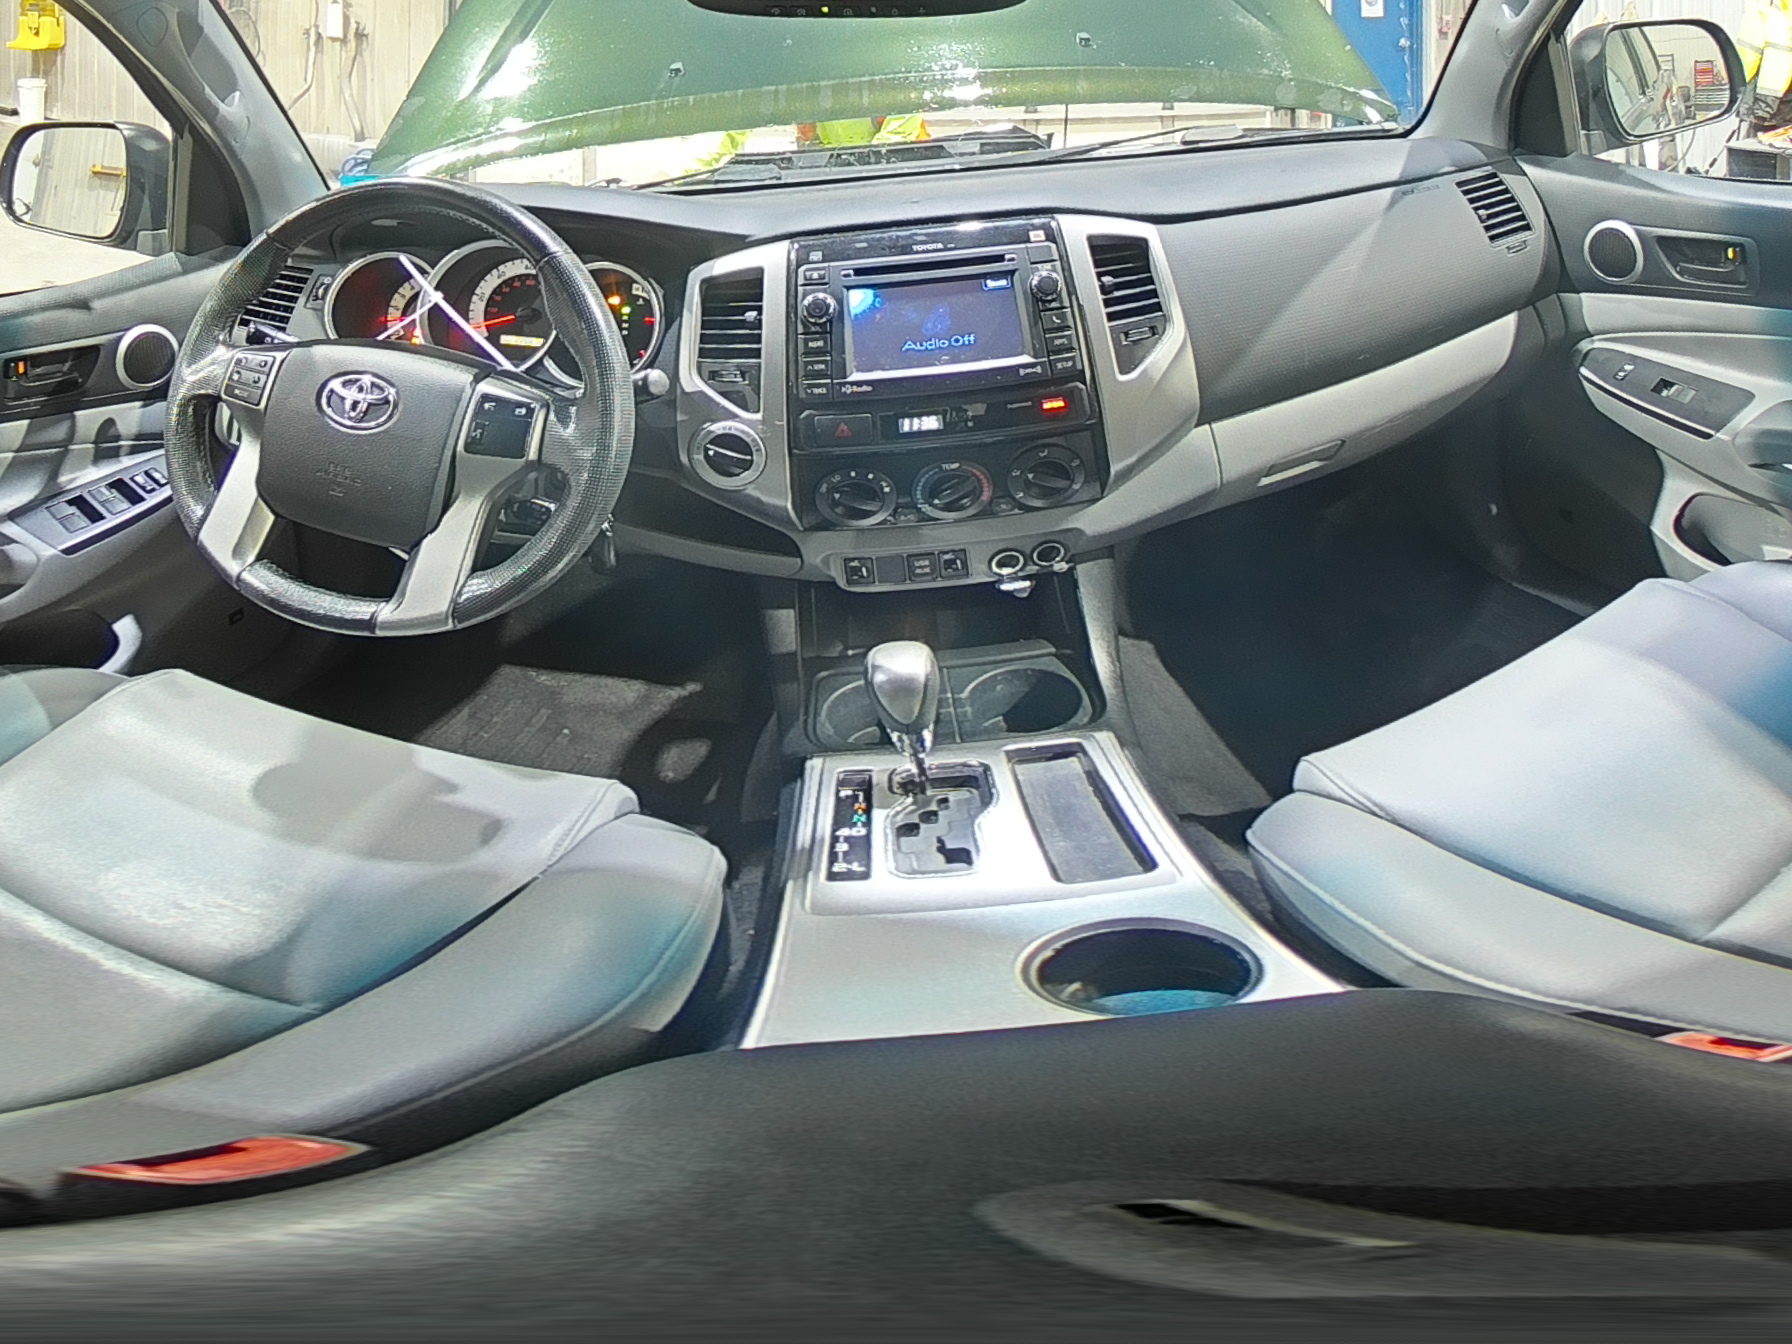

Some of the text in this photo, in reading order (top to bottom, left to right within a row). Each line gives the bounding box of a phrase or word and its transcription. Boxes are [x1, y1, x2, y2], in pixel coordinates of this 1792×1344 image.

[911, 242, 944, 251] TOYOTA
[901, 333, 976, 351] Audio Off
